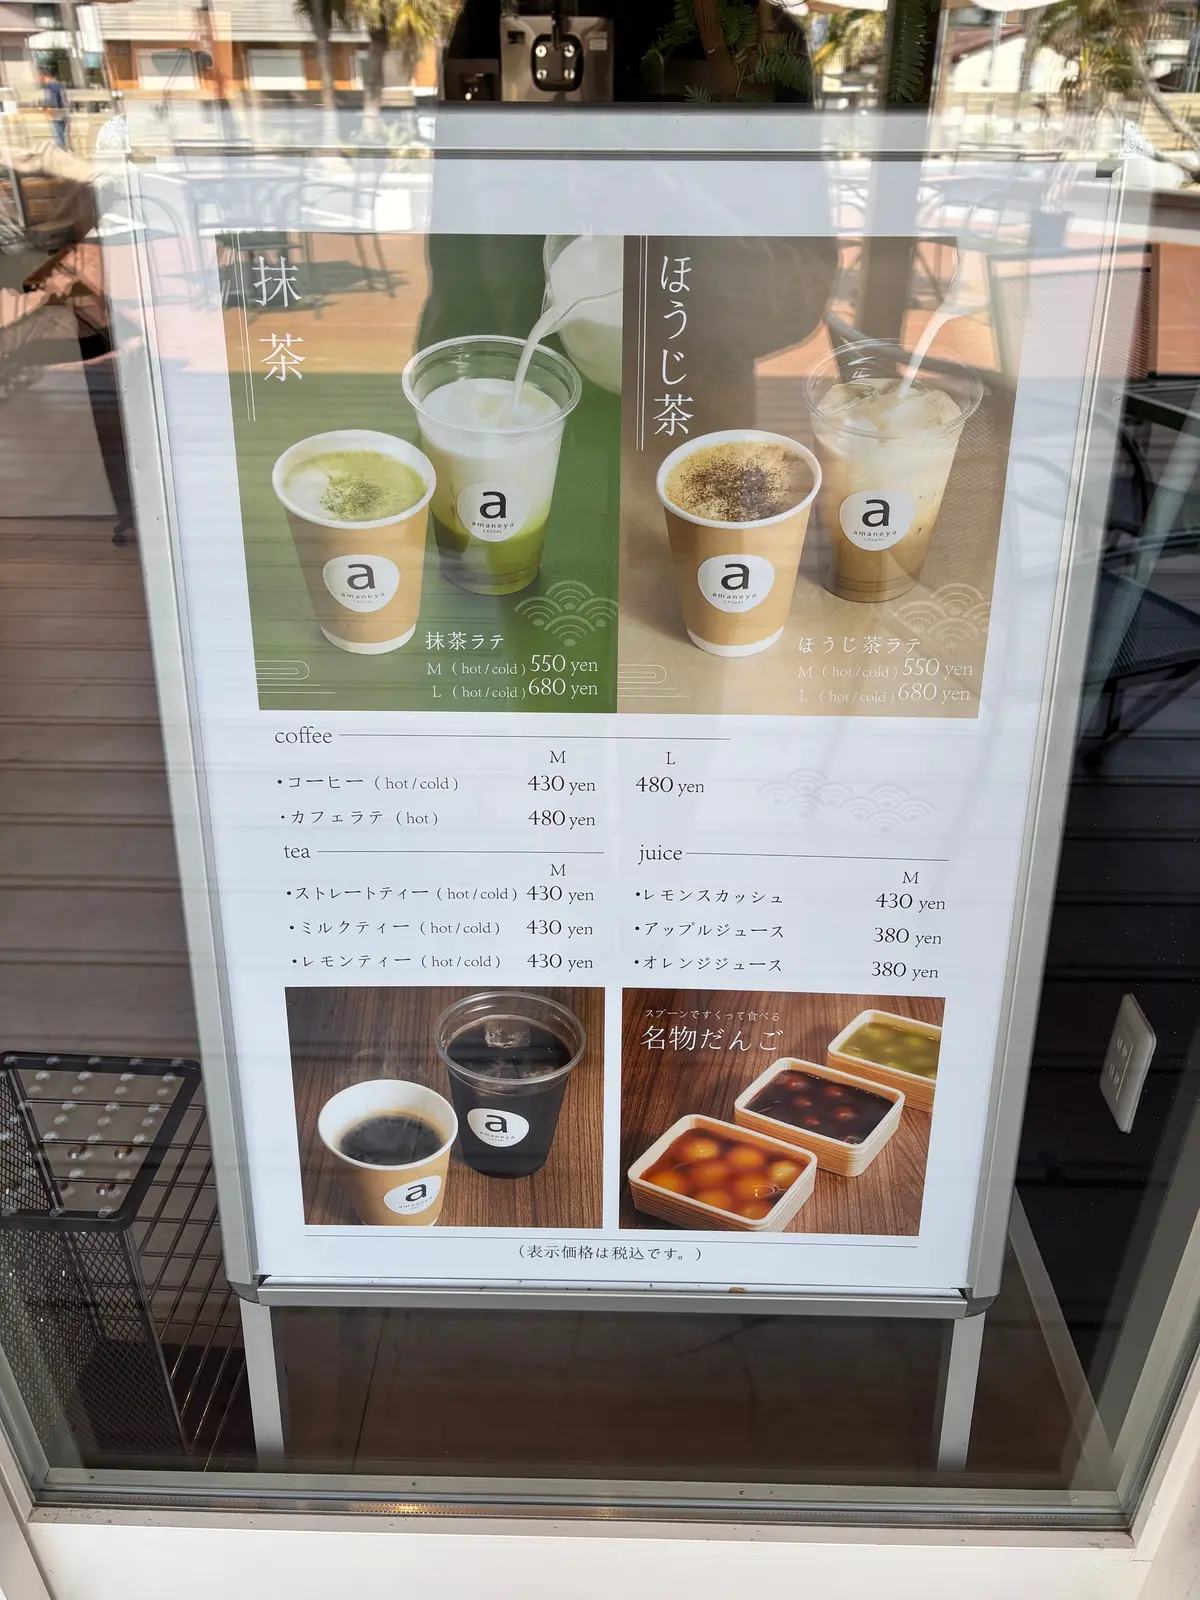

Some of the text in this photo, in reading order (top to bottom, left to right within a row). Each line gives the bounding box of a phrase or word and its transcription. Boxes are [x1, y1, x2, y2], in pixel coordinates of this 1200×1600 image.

[252, 255, 306, 382] 抹茶
[653, 255, 694, 436] ほうじ茶
[479, 490, 507, 519] a
[861, 499, 890, 527] a
[471, 521, 514, 529] amaneya
[346, 563, 376, 590] a
[720, 563, 750, 590] a
[712, 592, 757, 600] amaneya
[425, 631, 504, 650] 抹茶ラテ
[798, 636, 921, 654] ほうじ茶ラテ
[427, 663, 442, 675] M
[530, 654, 566, 672] 550
[570, 661, 599, 676] yen
[798, 666, 813, 678] M
[902, 658, 940, 676] 550
[944, 665, 973, 680] yen
[432, 686, 442, 698] L
[528, 678, 566, 696] 680
[570, 684, 599, 699] yen
[800, 690, 808, 702] L
[898, 682, 937, 701] 680
[942, 689, 970, 704] yen
[274, 726, 333, 744] coffee
[549, 750, 567, 764] M
[666, 752, 676, 765] L
[289, 775, 364, 789] コーヒー
[527, 775, 565, 792] 430
[569, 780, 596, 795] yen
[635, 776, 705, 796] 480 yen
[291, 810, 383, 825] カフェラテ
[528, 810, 565, 826] 480
[569, 814, 596, 830] yen
[284, 845, 311, 859] tea
[638, 844, 683, 865] juice
[549, 863, 567, 877] M
[902, 871, 919, 885] M
[296, 885, 429, 899] ストレートティー
[526, 885, 563, 901] 430
[568, 889, 594, 904] yen
[644, 889, 946, 913] レモンスカッシュ 430 yen
[301, 920, 410, 934] ミルクティー
[526, 919, 562, 935] 430
[567, 924, 593, 939] yen
[644, 921, 942, 947] アップルジュース 380 yen
[302, 954, 411, 968] レモンティー
[526, 952, 562, 969] 430
[568, 957, 593, 972] yen
[643, 955, 939, 981] オレンジジュース 380 yen
[645, 1009, 780, 1022] スプーンですくって食べる
[640, 1025, 783, 1051] 名物だんご
[485, 1114, 508, 1133] a
[405, 1184, 427, 1201] a
